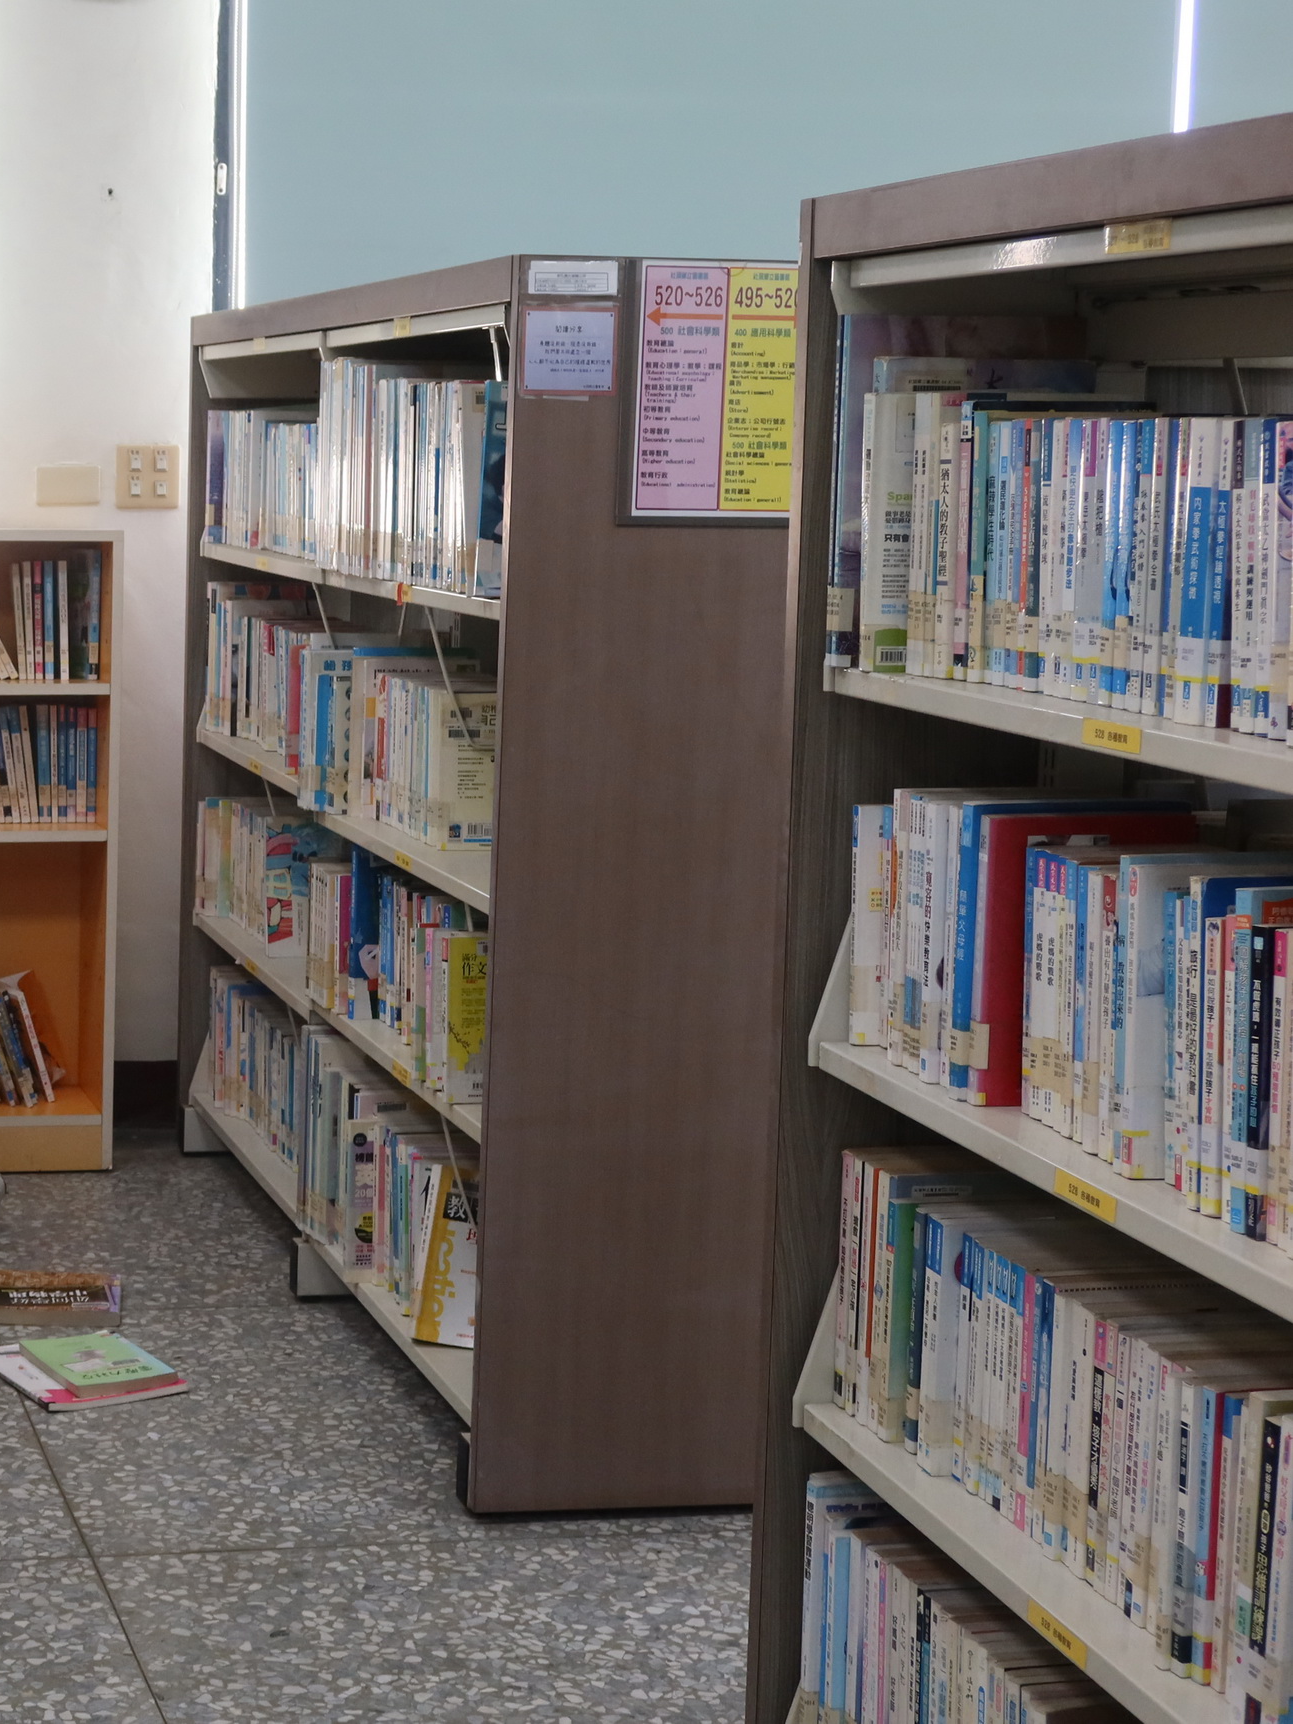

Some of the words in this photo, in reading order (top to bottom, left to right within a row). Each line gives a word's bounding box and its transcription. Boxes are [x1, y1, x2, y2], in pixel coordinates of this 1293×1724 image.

[654, 285, 723, 308] 520~526
[660, 326, 674, 335] 500
[677, 325, 720, 337] 社會科學類
[734, 328, 747, 337] 400
[750, 327, 791, 338] 應用科學類
[732, 441, 745, 449] 500
[747, 441, 787, 450] 社會科學類
[938, 467, 950, 577] 猶太人的教子聖經
[1041, 495, 1049, 564] 流星健身球
[1188, 496, 1203, 600] 內家拳武術探微
[1213, 501, 1227, 604] 太極拳經論透視
[1095, 728, 1105, 740] 528
[1107, 731, 1128, 744] 各種教育
[462, 961, 487, 976] 作文
[1035, 932, 1044, 982] 虎媽的戰歌
[1047, 936, 1055, 987] 虎媽的戰歌
[447, 1195, 466, 1219] 教
[1068, 1182, 1078, 1197] 528
[1080, 1189, 1101, 1209] 各種教育
[1040, 1616, 1051, 1632] 528
